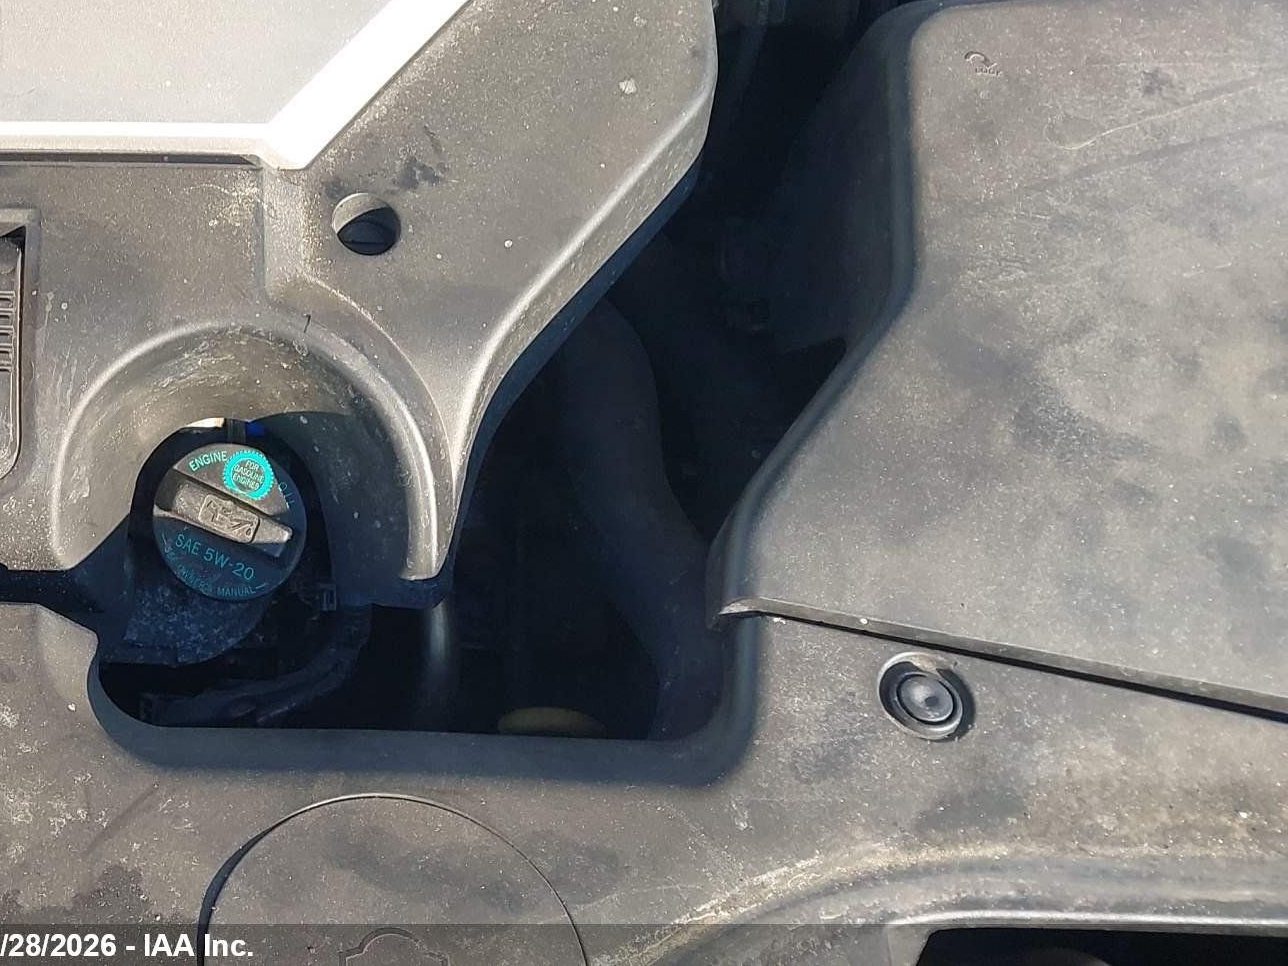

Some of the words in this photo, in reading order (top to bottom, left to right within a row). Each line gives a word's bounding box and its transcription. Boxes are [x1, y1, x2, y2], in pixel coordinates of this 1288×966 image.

[188, 450, 228, 471] ENGINE
[245, 460, 259, 470] FOR
[233, 464, 264, 482] GASOLINE
[175, 533, 201, 556] SAE
[203, 547, 254, 581] 5W-20
[216, 587, 255, 597] MANUAL
